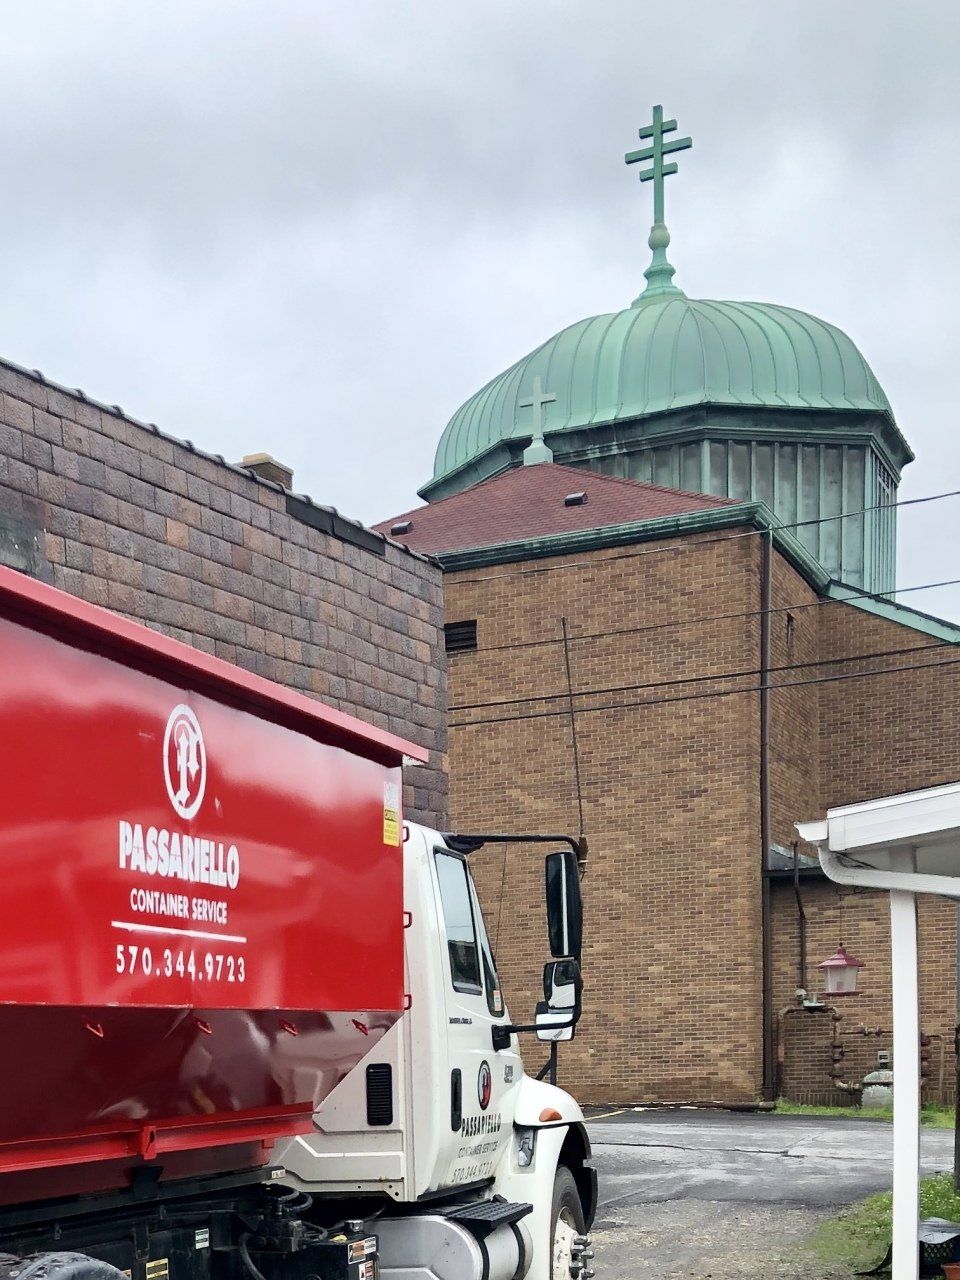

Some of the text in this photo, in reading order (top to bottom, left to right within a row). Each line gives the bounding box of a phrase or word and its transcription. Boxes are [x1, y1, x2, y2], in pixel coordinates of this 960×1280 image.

[119, 820, 240, 889] PASSARIELLO
[130, 888, 227, 924] CONTAINER SERVICE
[116, 945, 245, 983] 570.344.9723
[461, 1113, 501, 1137] PASSARIELLO
